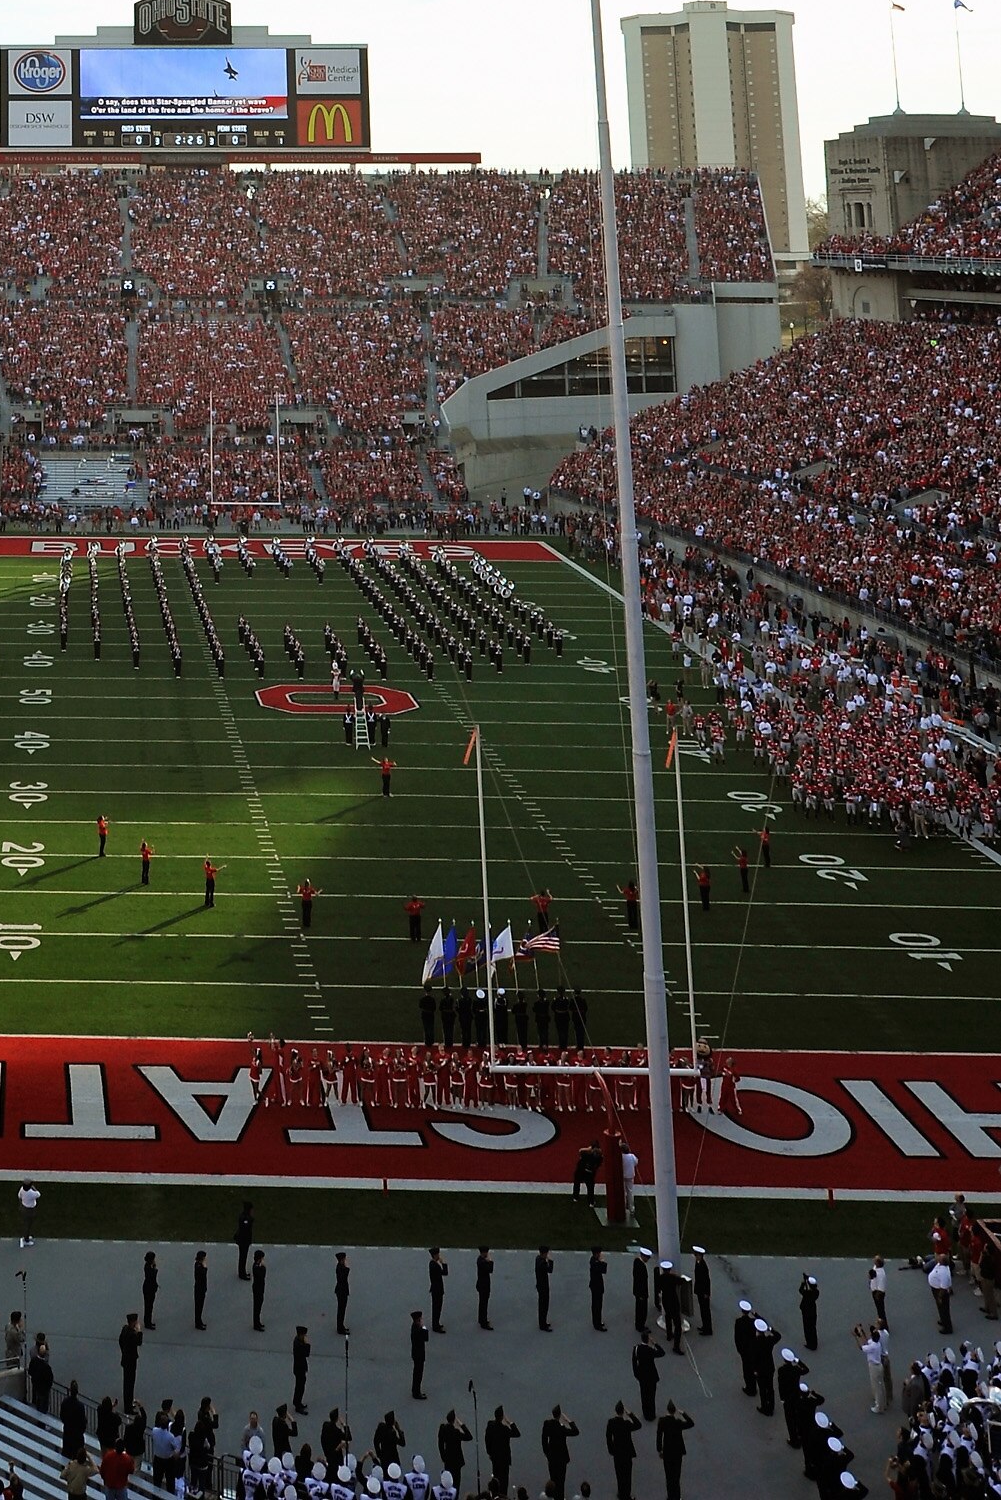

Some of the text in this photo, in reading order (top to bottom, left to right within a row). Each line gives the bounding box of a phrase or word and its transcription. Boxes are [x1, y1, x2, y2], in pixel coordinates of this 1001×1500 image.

[20, 56, 62, 88] Kroger
[328, 66, 359, 74] Medical
[328, 74, 354, 82] Center
[121, 98, 138, 106] does
[140, 98, 155, 106] that
[207, 98, 234, 106] Banner
[234, 98, 247, 106] yet
[248, 98, 267, 106] wave
[107, 106, 120, 114] the
[121, 106, 137, 114] land
[138, 106, 147, 114] of
[147, 106, 160, 114] the
[161, 106, 176, 114] free
[177, 106, 191, 114] and
[192, 106, 204, 114] the
[205, 106, 226, 114] home
[226, 106, 235, 114] of
[236, 106, 249, 114] the
[249, 106, 274, 114] brave?
[25, 112, 56, 124] DSW
[217, 124, 247, 132] PENN STATE
[135, 135, 142, 145] 0
[154, 137, 160, 146] 3
[175, 135, 204, 145] 2:26
[209, 137, 215, 146] 3
[232, 135, 239, 145] 0
[31, 541, 475, 557] BUCKEYES
[26, 620, 55, 635] 30
[23, 651, 54, 668] 40
[19, 688, 52, 705] 50
[14, 731, 50, 750] 40
[9, 781, 49, 803] 30
[726, 790, 783, 814] 30
[0, 840, 45, 868] 20
[798, 853, 870, 881] 20
[888, 931, 964, 961] 10
